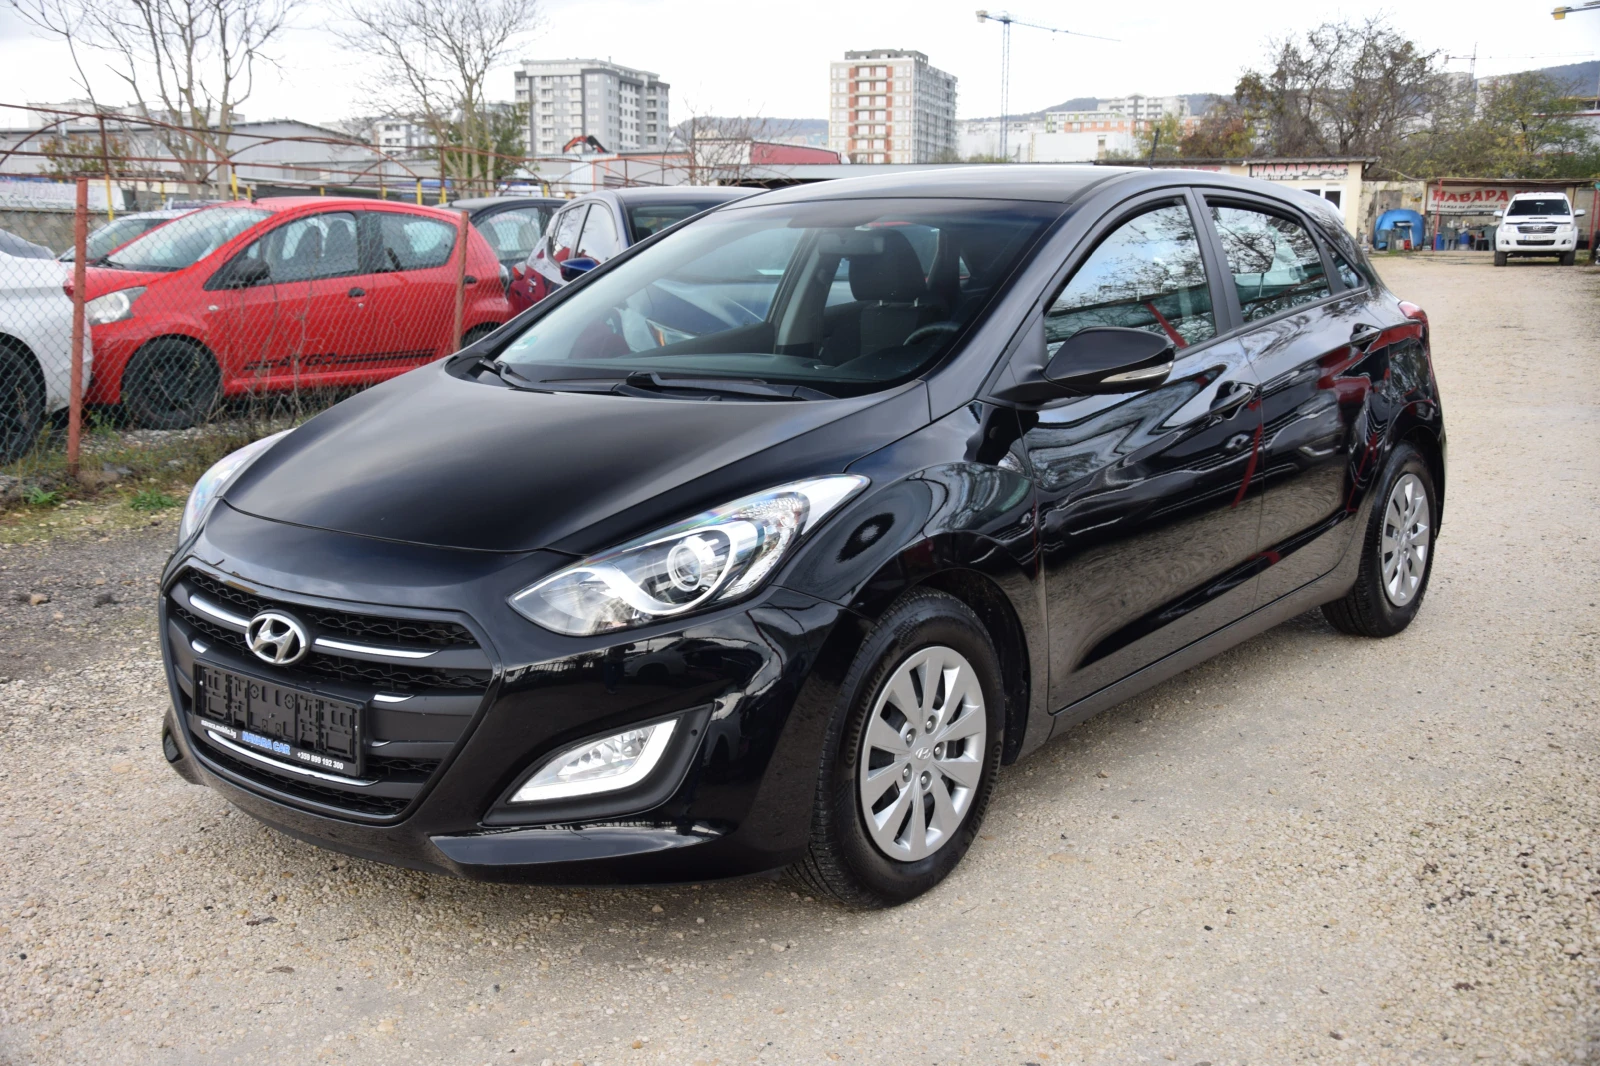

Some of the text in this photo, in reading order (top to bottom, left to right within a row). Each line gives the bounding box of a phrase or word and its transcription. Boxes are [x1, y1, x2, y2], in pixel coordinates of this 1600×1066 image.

[1432, 189, 1509, 203] НАВАРА
[242, 730, 273, 750] NAVARA
[273, 740, 291, 755] CAR
[297, 751, 310, 761] +359
[322, 757, 332, 767] 192
